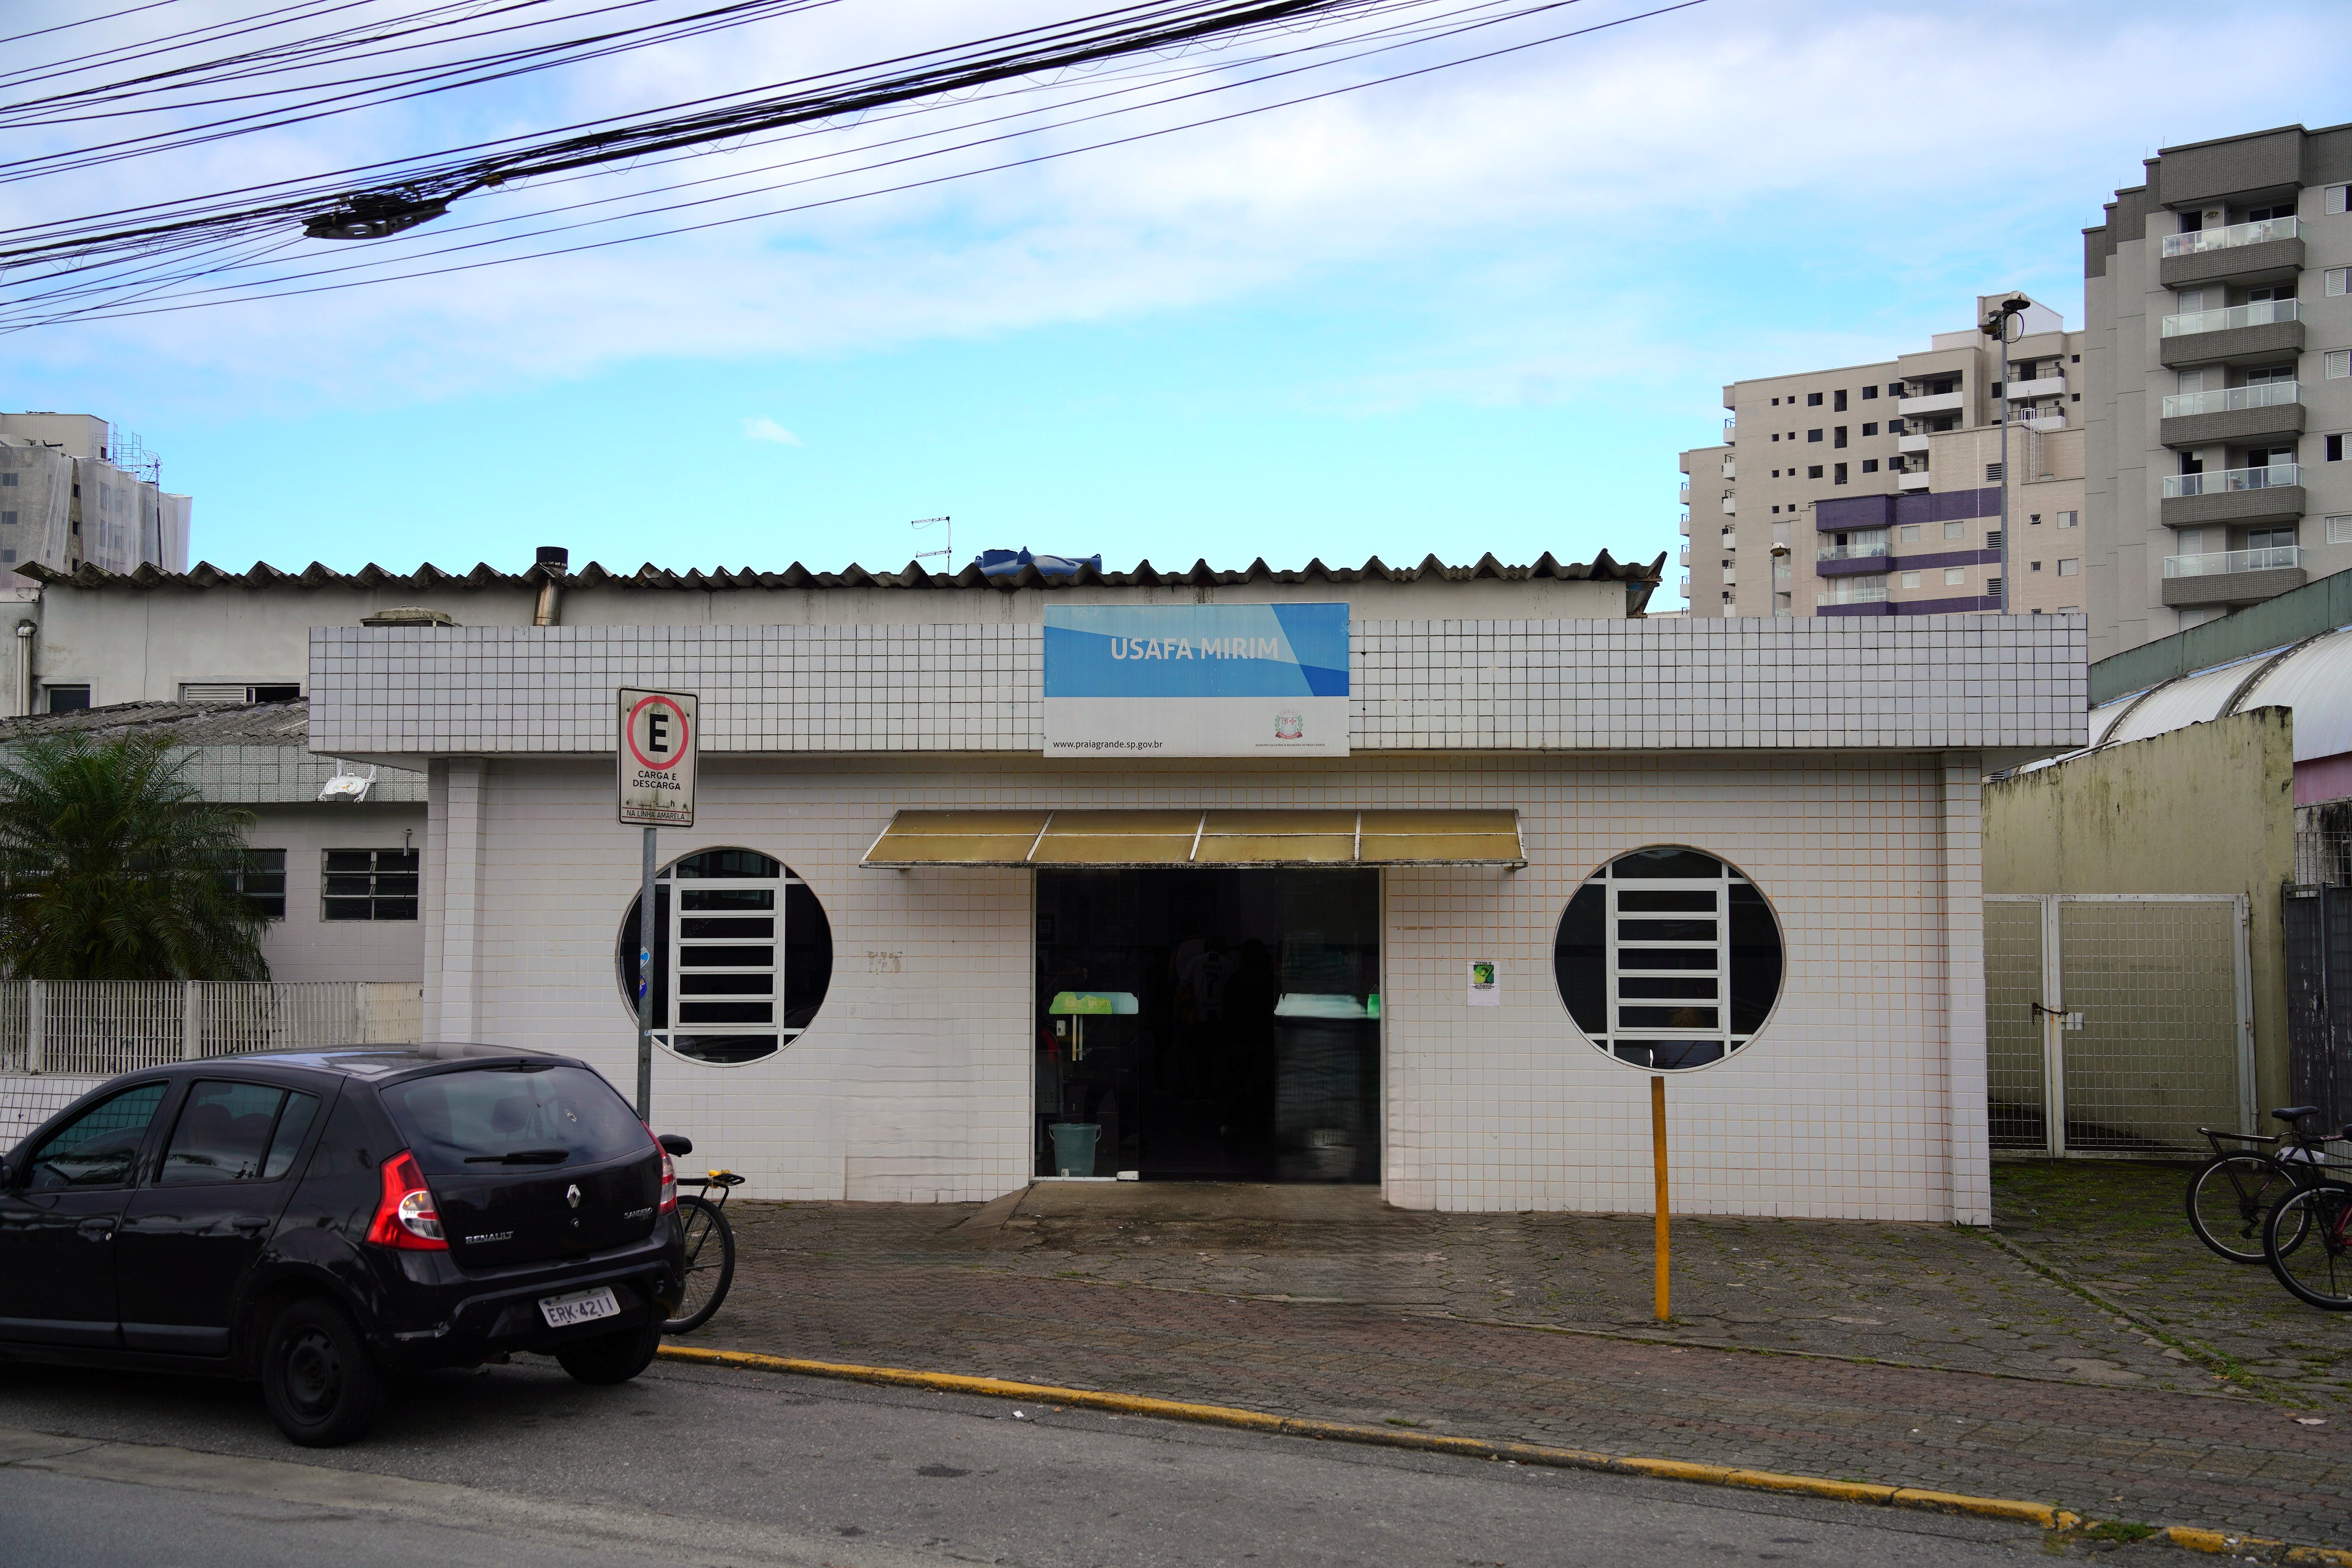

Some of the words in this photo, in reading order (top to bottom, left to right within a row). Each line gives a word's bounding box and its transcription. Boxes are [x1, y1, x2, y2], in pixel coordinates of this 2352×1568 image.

[1111, 638, 1193, 659] USAFA
[1201, 637, 1278, 659] MIRIM
[649, 713, 668, 753] E
[1053, 740, 1163, 750] www.praiagrande.sp.gov.br
[638, 770, 669, 780] CARGA
[633, 779, 681, 790] DESCARGA
[657, 812, 685, 820] AMARELA
[624, 1207, 653, 1219] SANDERO
[465, 1231, 514, 1244] RENAULT
